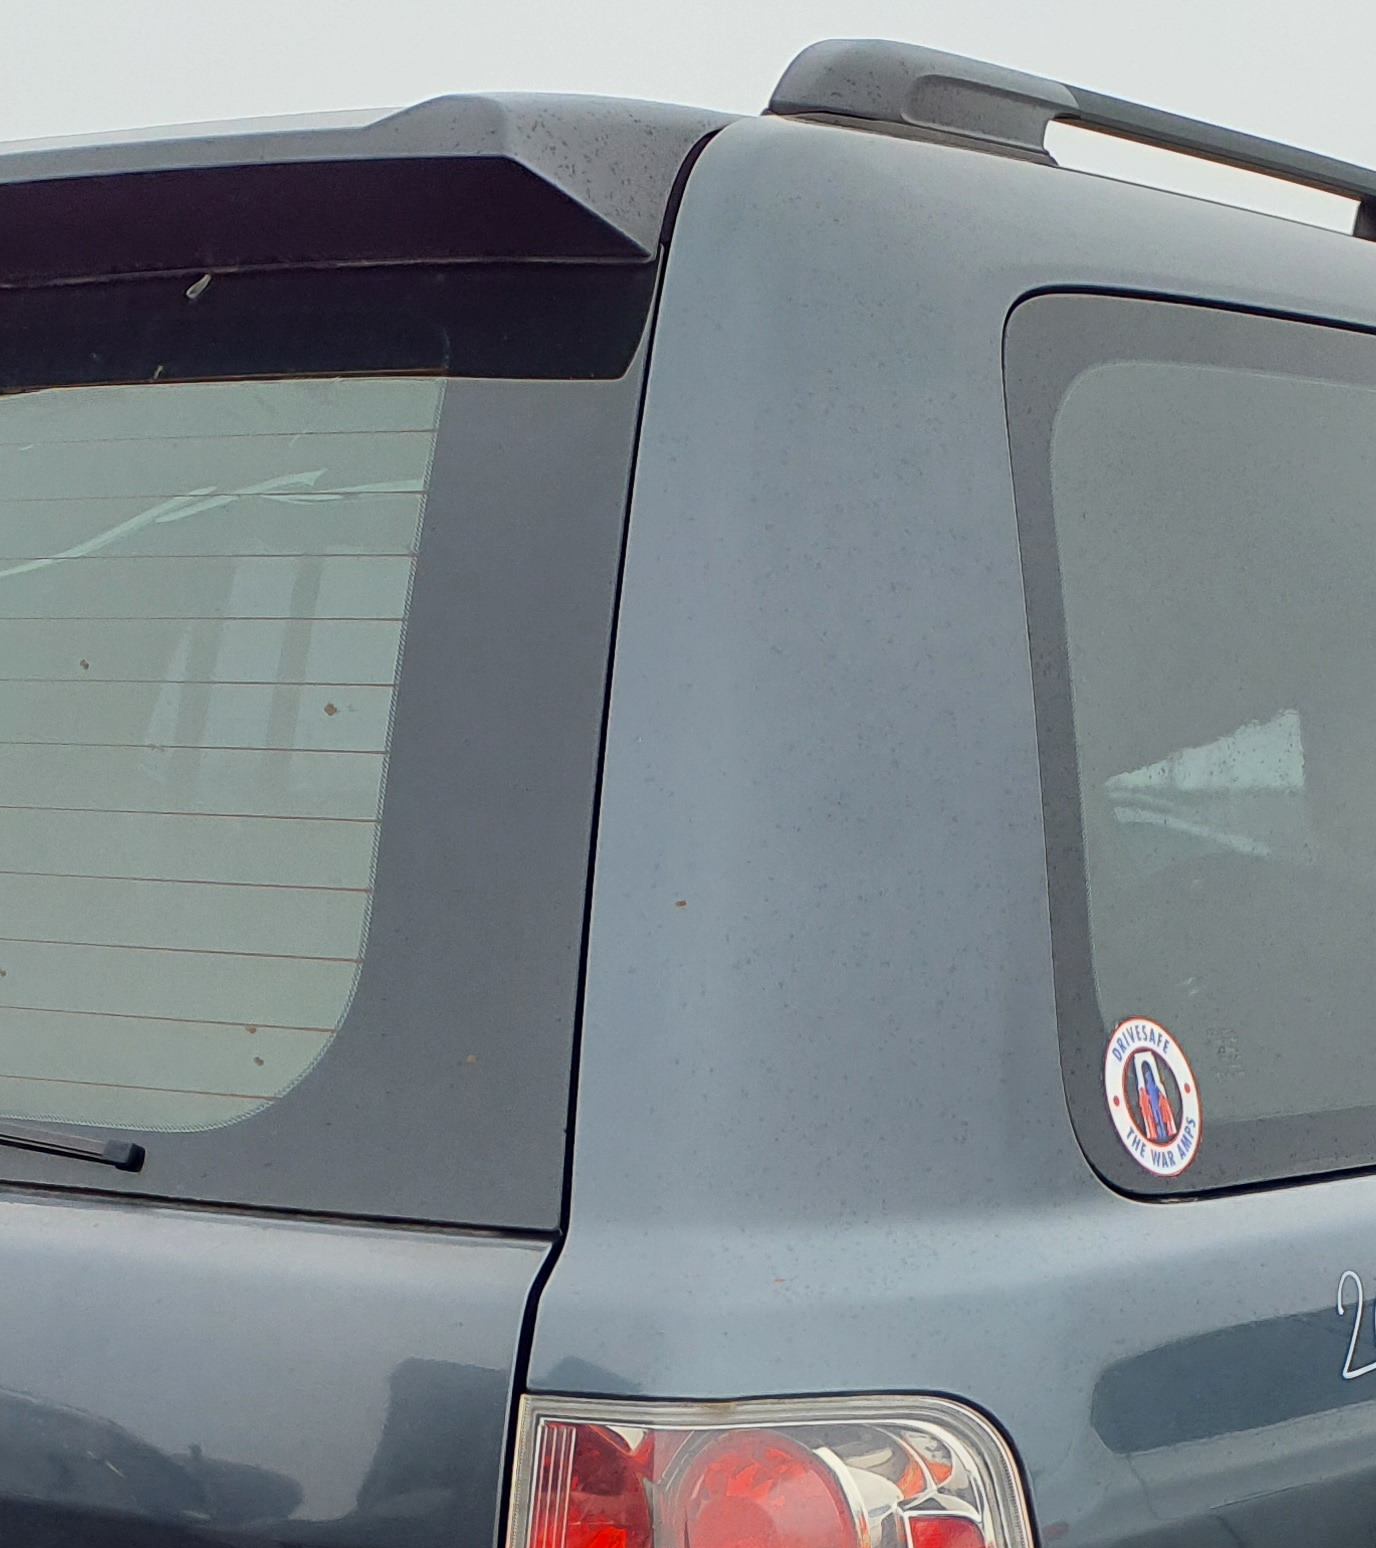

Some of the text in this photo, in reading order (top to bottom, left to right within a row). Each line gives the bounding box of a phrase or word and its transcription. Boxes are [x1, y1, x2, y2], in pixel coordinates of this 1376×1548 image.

[1111, 1024, 1171, 1063] DRIVESAFE
[1126, 1116, 1197, 1169] THE WAR AMPS
